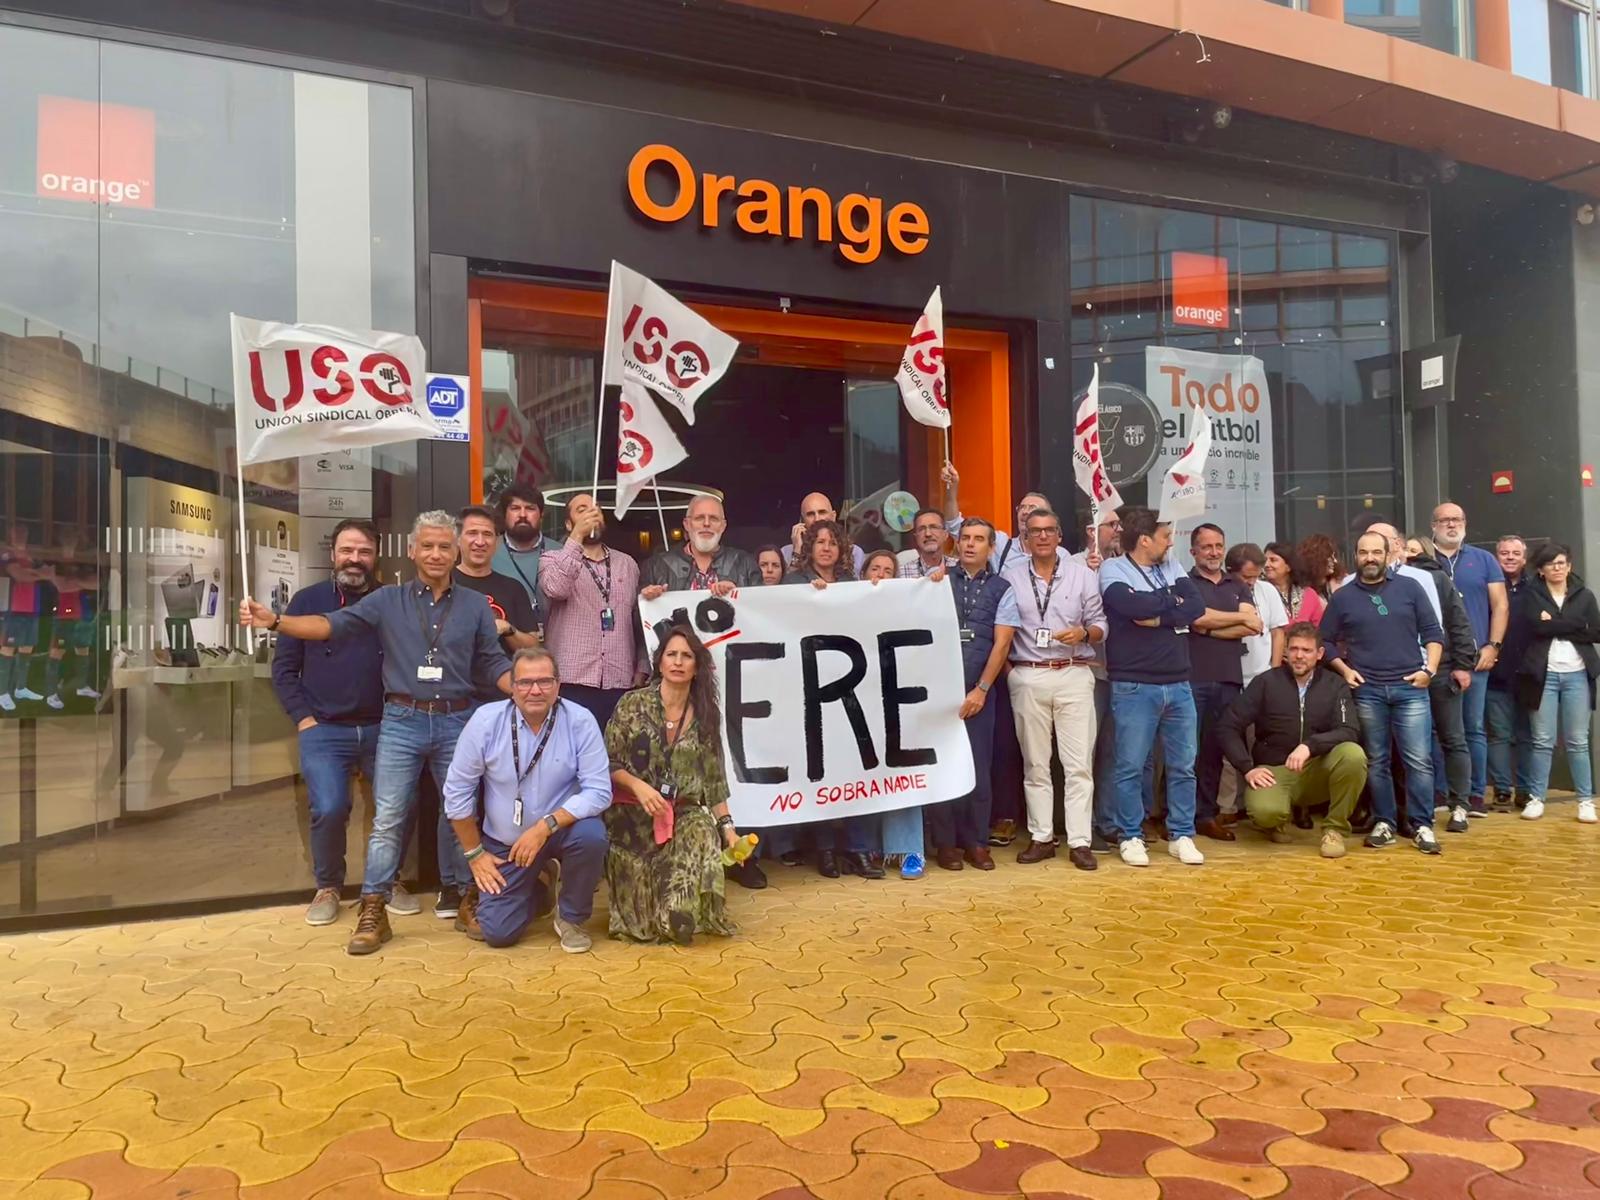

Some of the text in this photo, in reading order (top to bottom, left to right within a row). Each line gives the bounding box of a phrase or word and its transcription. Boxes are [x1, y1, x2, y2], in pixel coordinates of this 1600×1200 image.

[627, 143, 931, 264] Orange
[248, 345, 413, 413] USO
[430, 390, 458, 405] ADT
[1160, 365, 1260, 414] Todo
[255, 414, 302, 430] UNION
[306, 409, 372, 425] SINDICAL
[1162, 413, 1260, 444] el útbol
[170, 499, 212, 521] SAMSUNG
[725, 629, 938, 784] ERE
[770, 774, 927, 812] NO SOBRA NADIE
